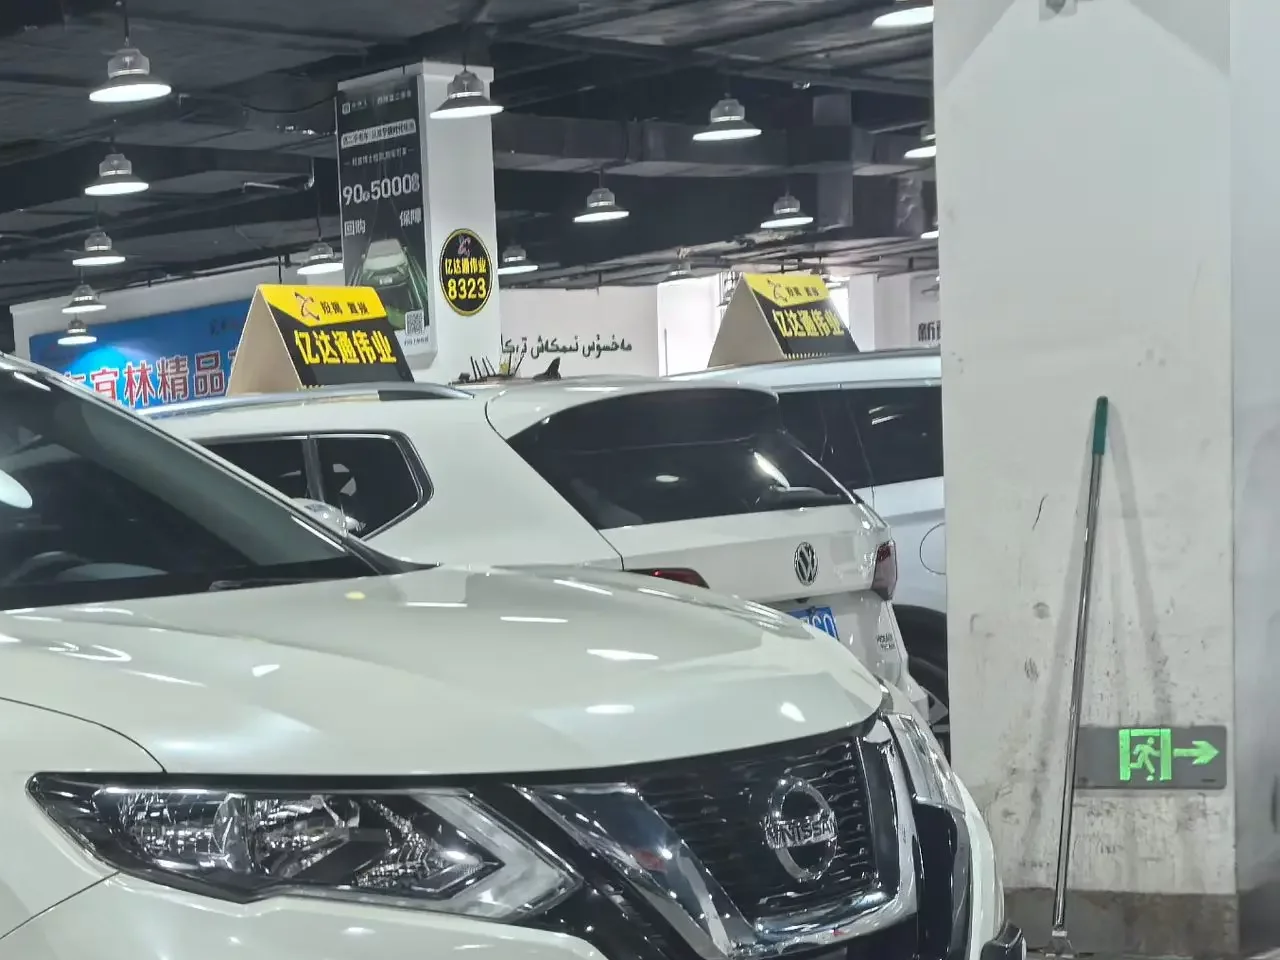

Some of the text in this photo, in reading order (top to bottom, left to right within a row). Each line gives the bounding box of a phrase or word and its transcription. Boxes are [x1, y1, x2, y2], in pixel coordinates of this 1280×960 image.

[445, 256, 487, 275] 亿达通伟业
[448, 277, 487, 300] 8323
[293, 329, 397, 365] 亿达通伟业
[65, 350, 237, 408] 宜林精品
